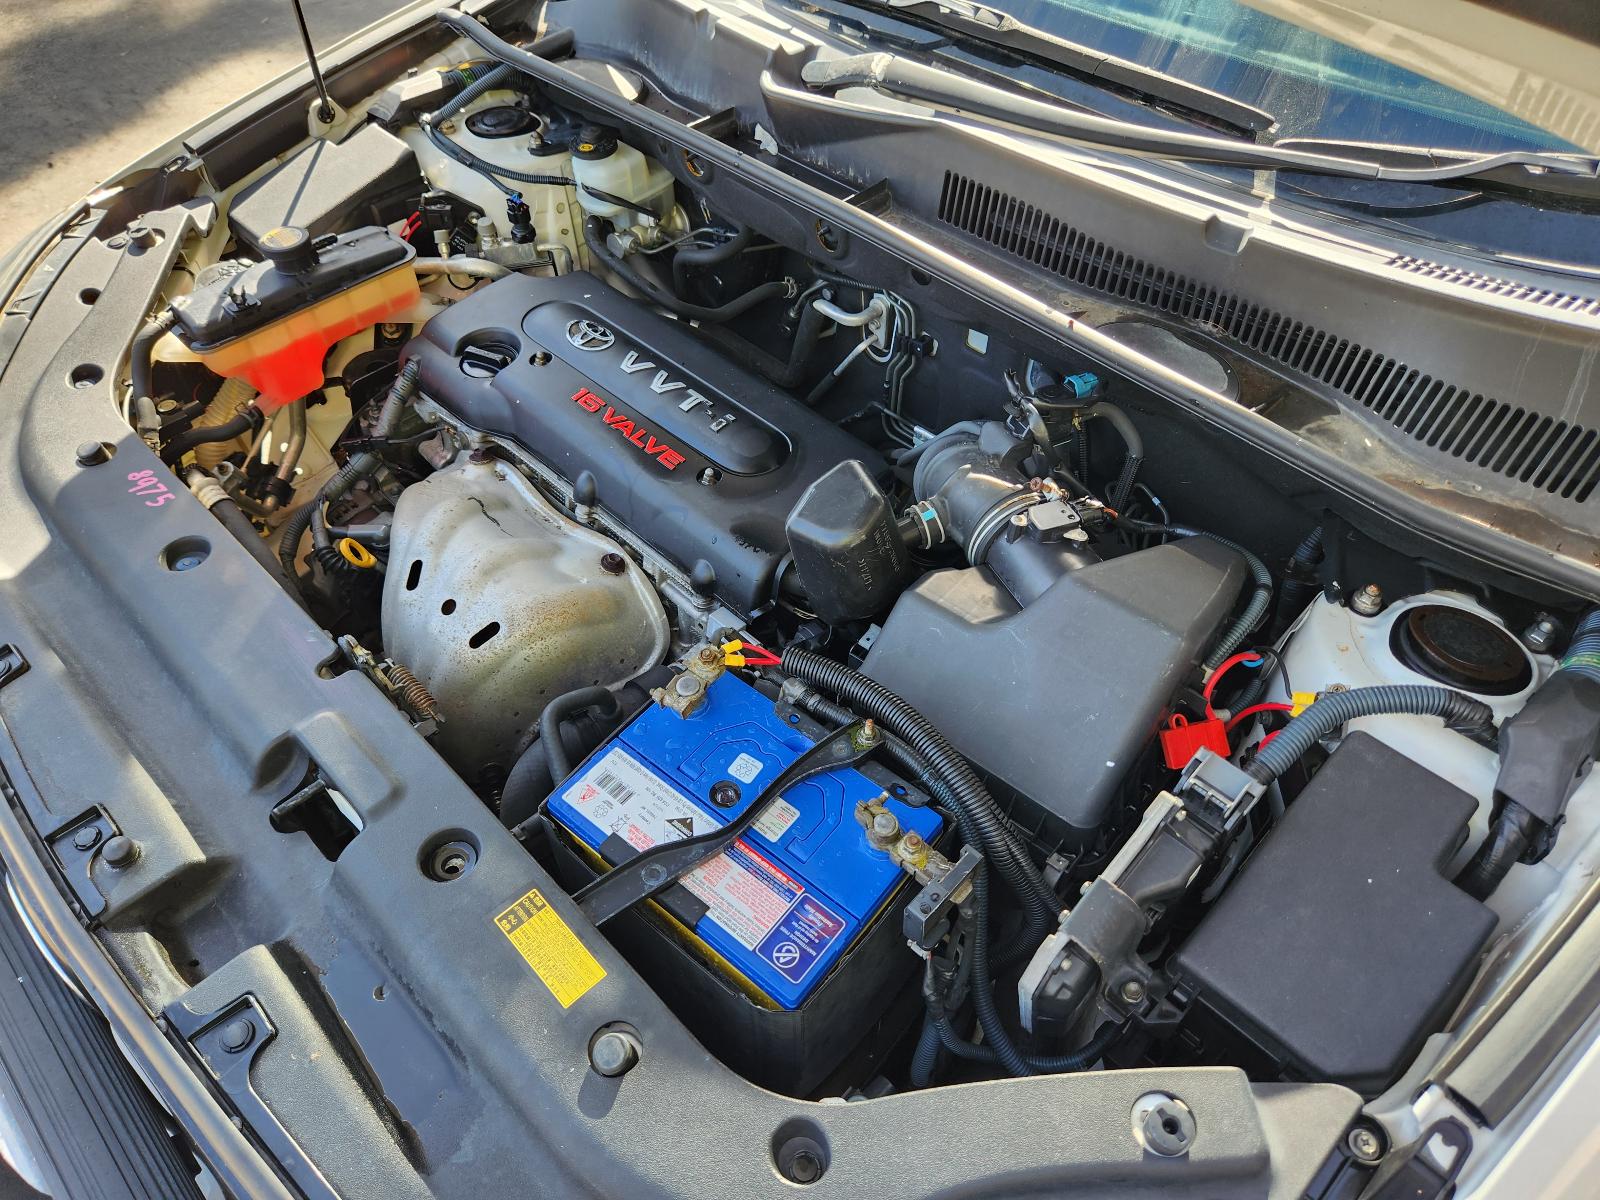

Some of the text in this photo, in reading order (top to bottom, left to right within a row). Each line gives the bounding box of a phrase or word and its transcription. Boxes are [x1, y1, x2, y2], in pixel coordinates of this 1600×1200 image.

[571, 387, 686, 470] 16 VALVE
[619, 350, 736, 432] VVT-i
[127, 469, 176, 507] 8975
